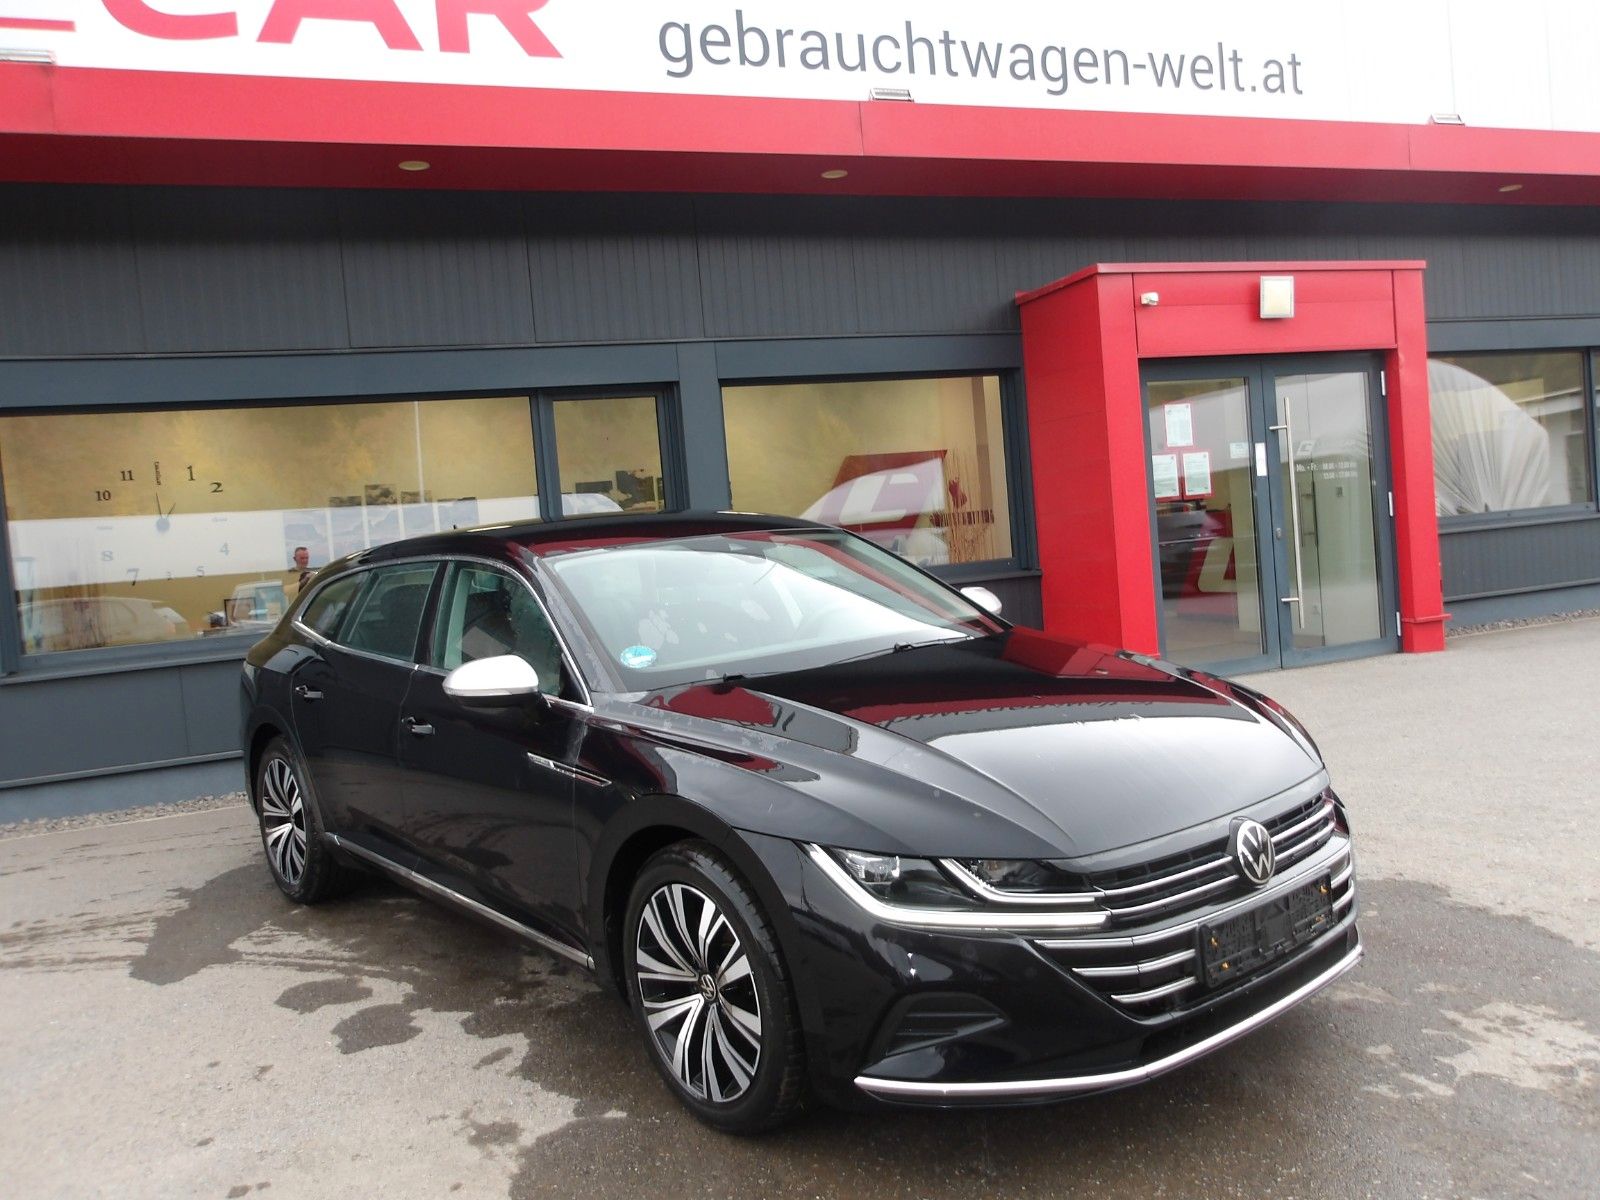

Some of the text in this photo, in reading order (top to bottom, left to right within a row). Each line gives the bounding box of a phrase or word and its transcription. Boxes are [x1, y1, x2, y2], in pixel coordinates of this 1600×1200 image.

[659, 10, 1303, 96] gebrauchtwagen-welt.at
[120, 470, 134, 481] 11
[187, 465, 195, 481] 1
[210, 482, 223, 493] 2
[96, 490, 111, 501] 10
[127, 568, 139, 586] 7
